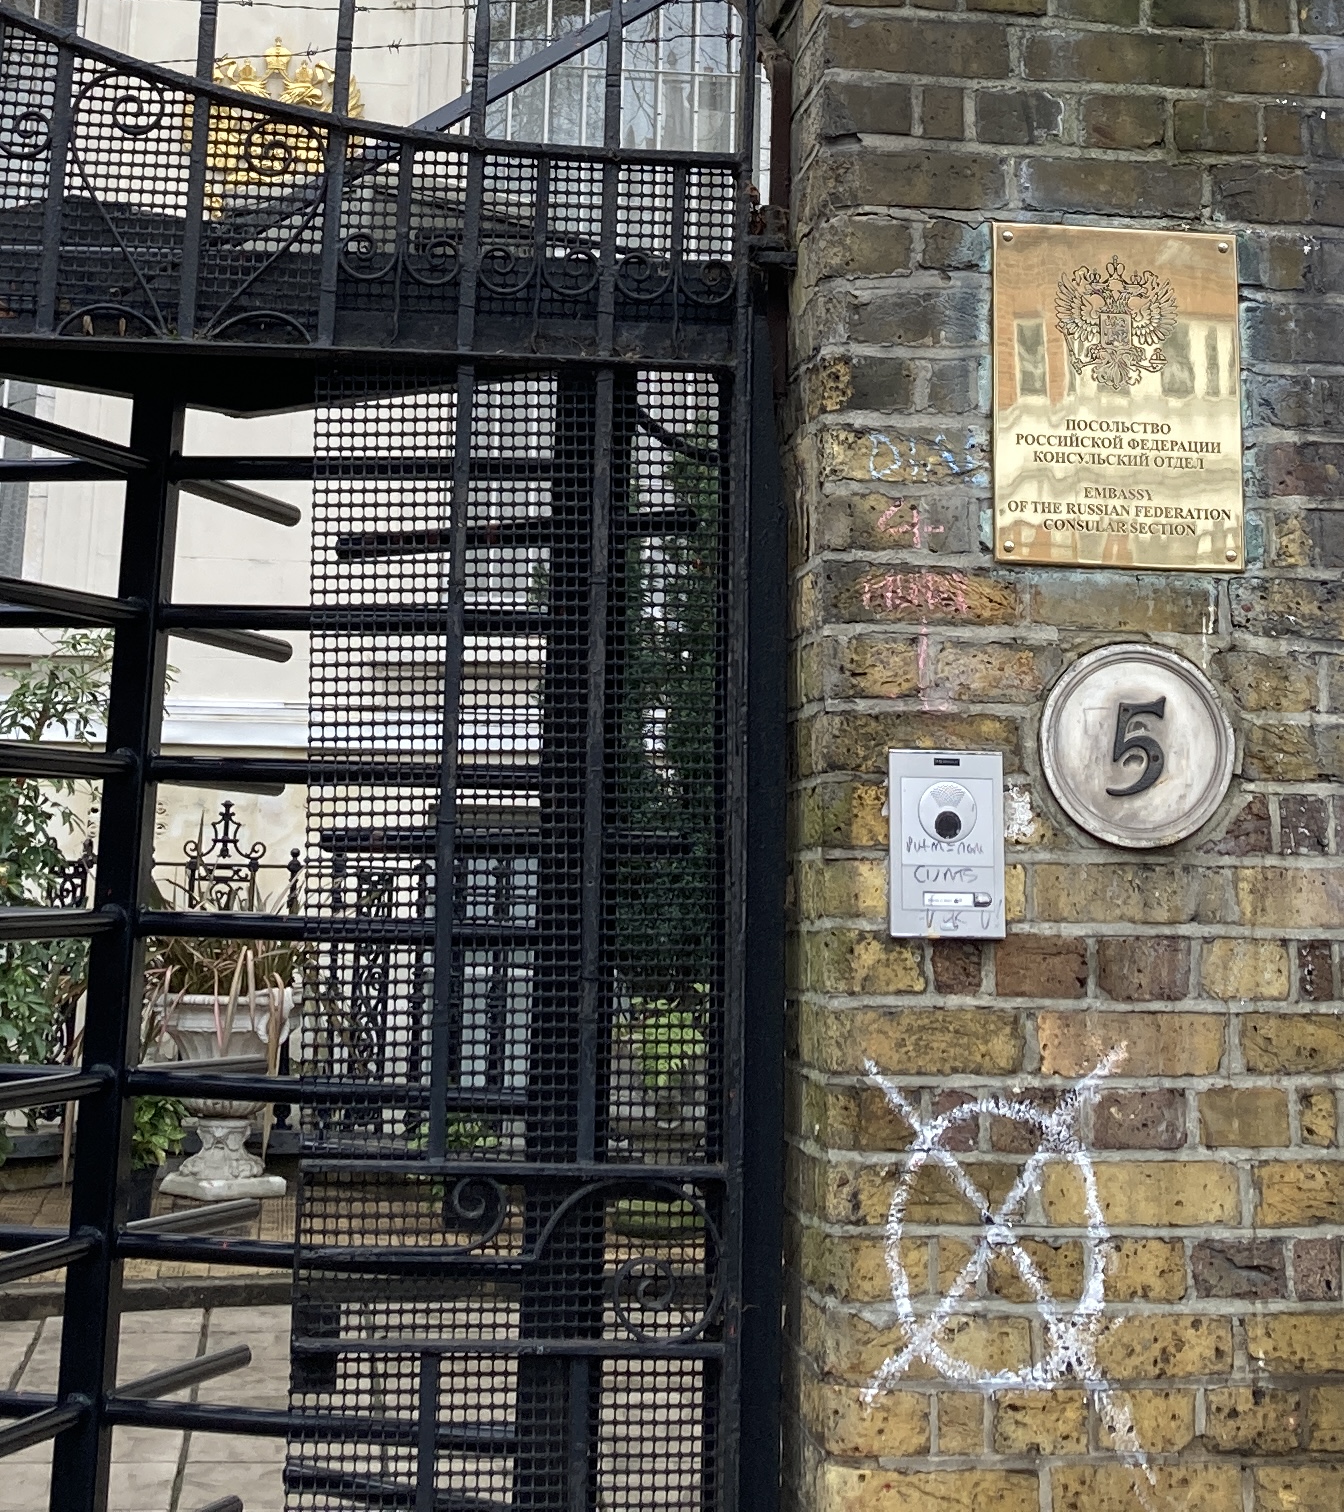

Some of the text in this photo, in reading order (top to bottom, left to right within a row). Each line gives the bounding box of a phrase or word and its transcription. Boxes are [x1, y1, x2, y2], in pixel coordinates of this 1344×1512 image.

[1065, 418, 1172, 435] ПОСОЛЬСТВО
[1015, 432, 1222, 454] РОССИЙСКОЙ ФЕДЕРАЦИИ
[1033, 450, 1205, 470] КОНСУЛЬСКИЙ ОТДЕЛ
[1083, 486, 1154, 502] EMBASSY
[1007, 500, 1232, 521] OF THE RUSSIAN FEDERATION
[1043, 518, 1197, 537] CONSULAR SECTION
[1105, 695, 1167, 797] 5
